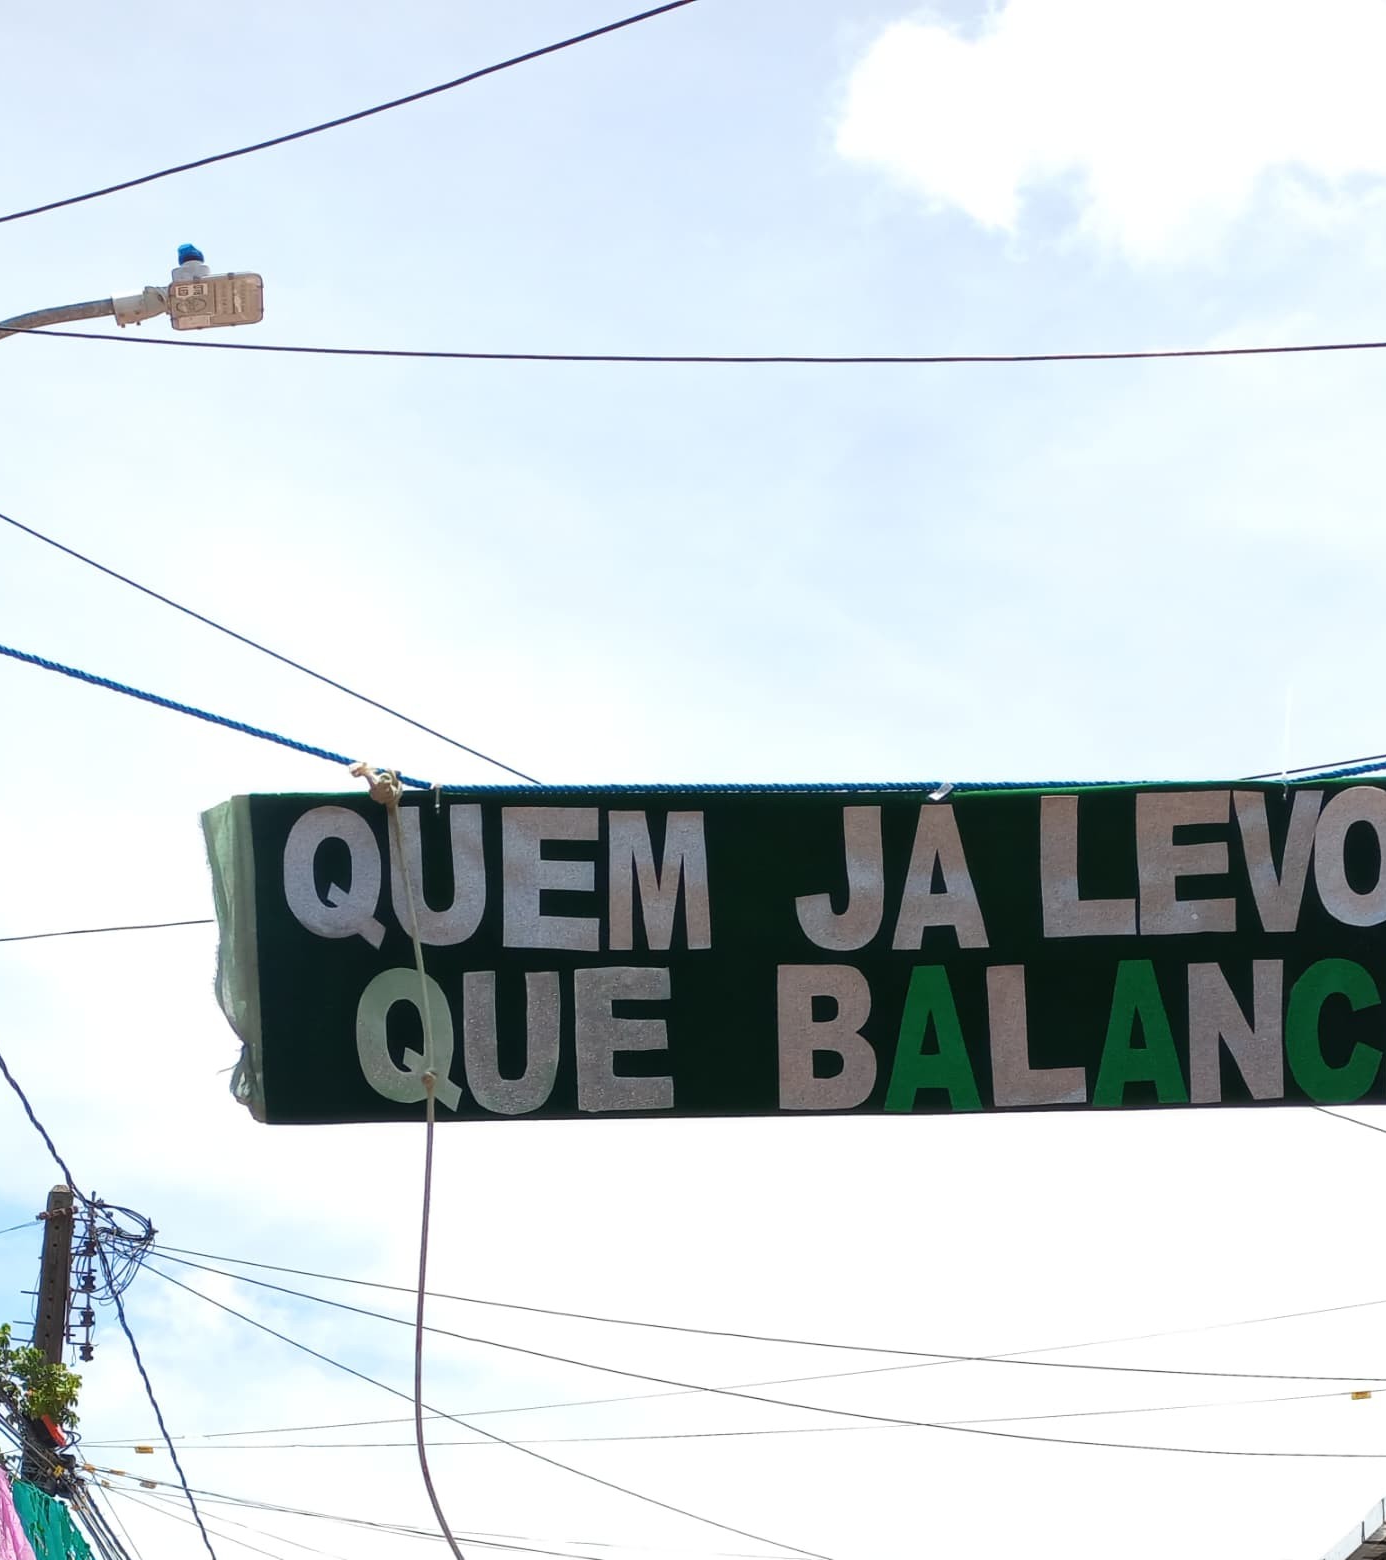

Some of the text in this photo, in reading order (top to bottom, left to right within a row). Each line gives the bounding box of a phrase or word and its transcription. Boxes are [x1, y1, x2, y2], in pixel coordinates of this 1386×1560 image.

[283, 803, 711, 951] QUEM
[795, 803, 989, 950] JA
[355, 966, 674, 1115] QUE
